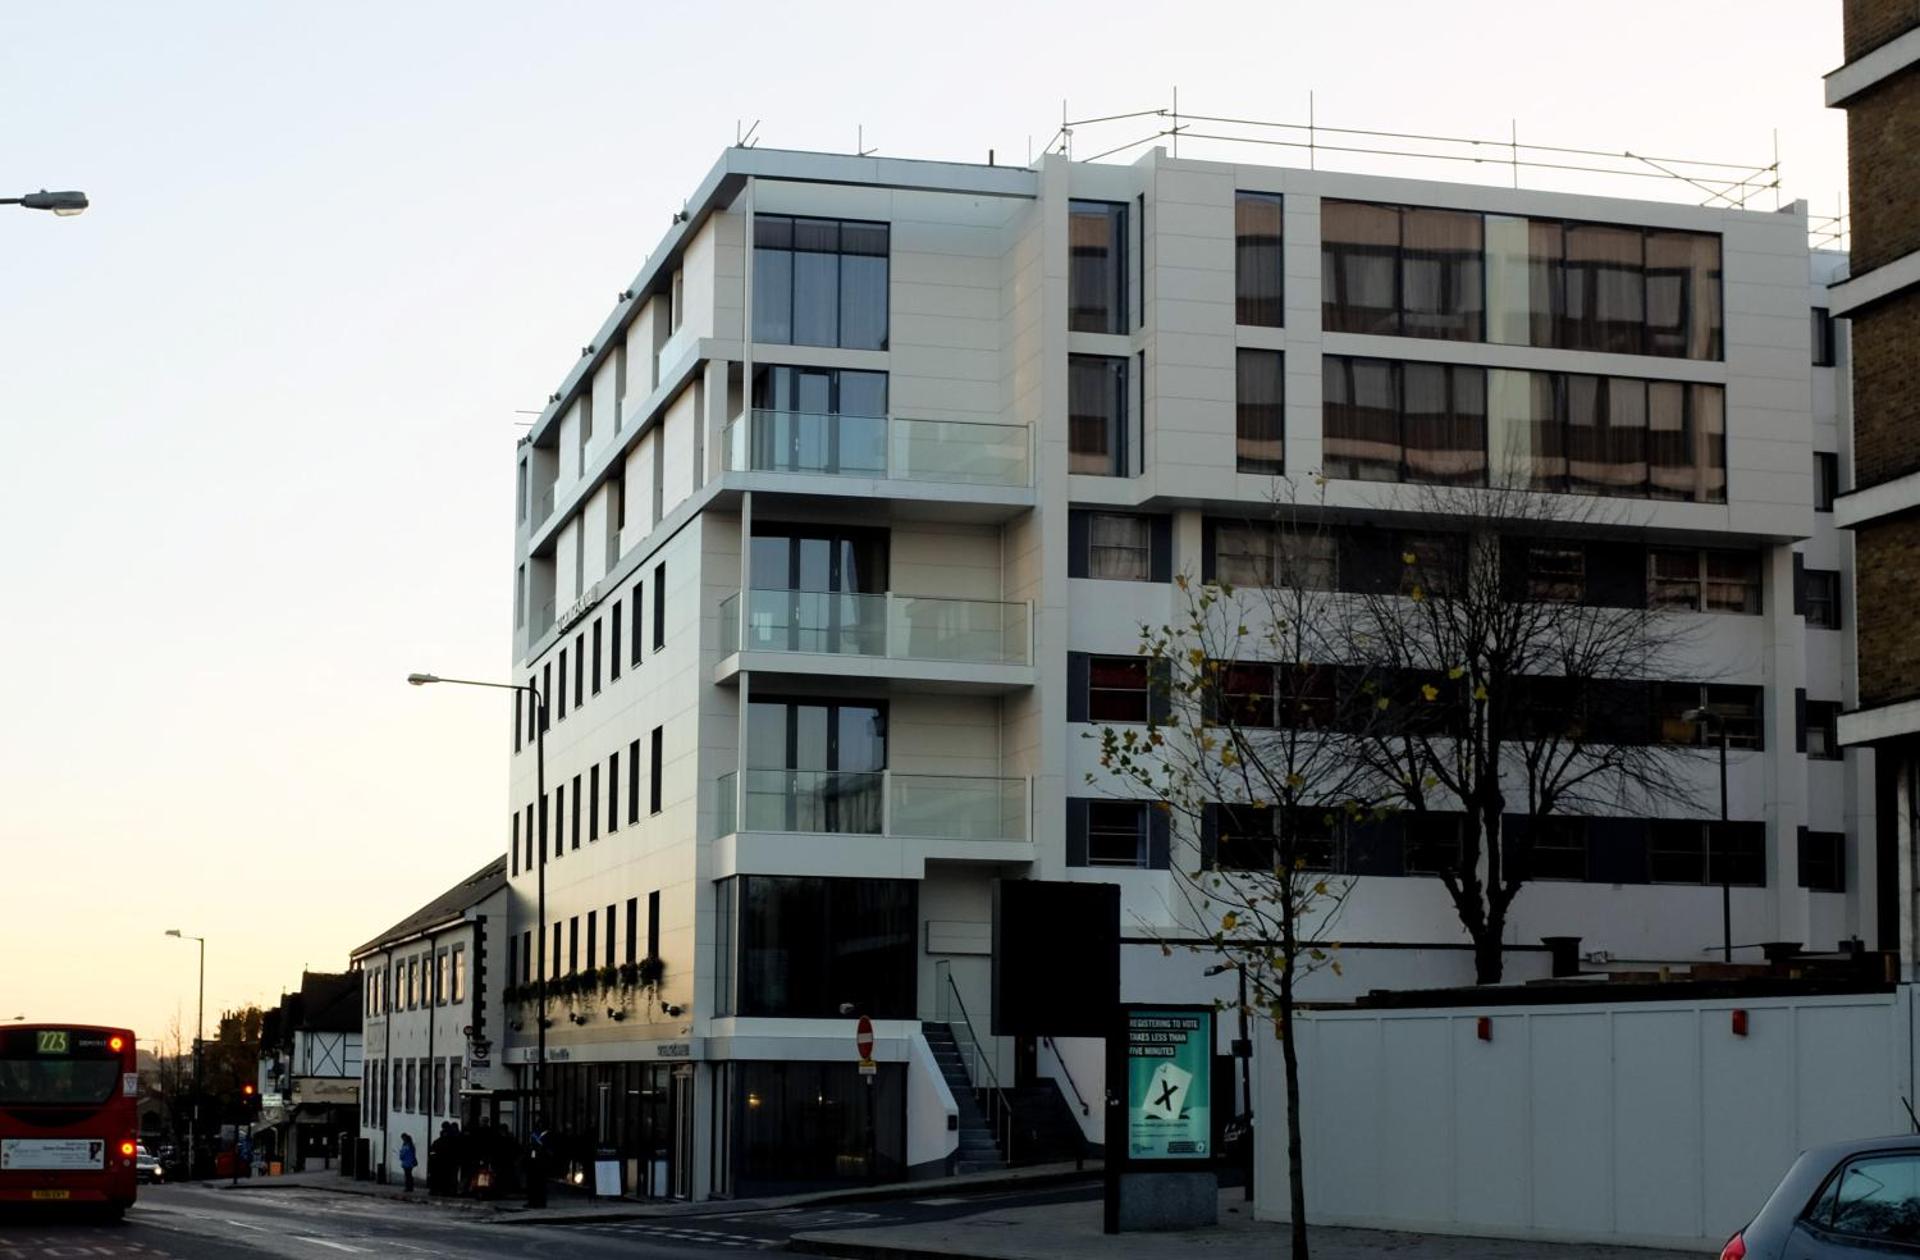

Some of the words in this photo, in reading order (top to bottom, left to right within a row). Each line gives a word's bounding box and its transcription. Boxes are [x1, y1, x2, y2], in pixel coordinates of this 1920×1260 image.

[1129, 1019, 1171, 1028] REGISTERING
[1173, 1020, 1181, 1028] TO
[1182, 1020, 1198, 1029] VOTE
[40, 1031, 66, 1052] 223
[1129, 1032, 1150, 1042] TAKES
[1151, 1032, 1168, 1042] LESS
[1169, 1033, 1187, 1042] THAN
[1144, 1046, 1174, 1056] MINUTES
